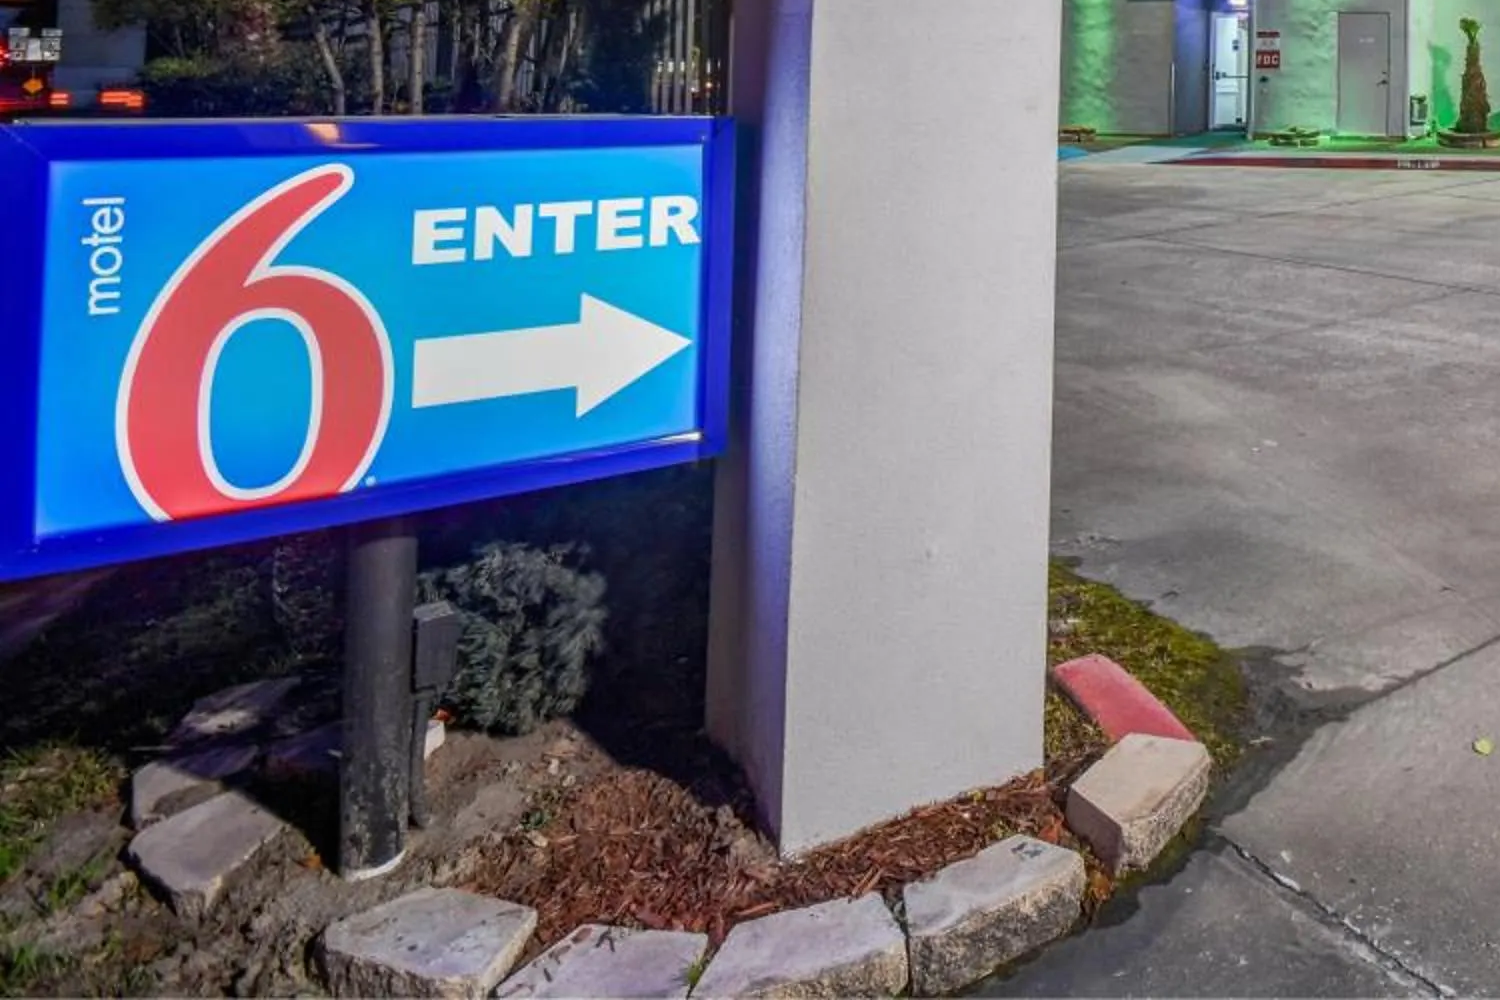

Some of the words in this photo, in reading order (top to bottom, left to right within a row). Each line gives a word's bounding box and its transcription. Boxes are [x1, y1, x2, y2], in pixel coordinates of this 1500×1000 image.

[81, 197, 125, 316] motel
[411, 195, 701, 266] ENTER
[115, 162, 395, 523] 6
